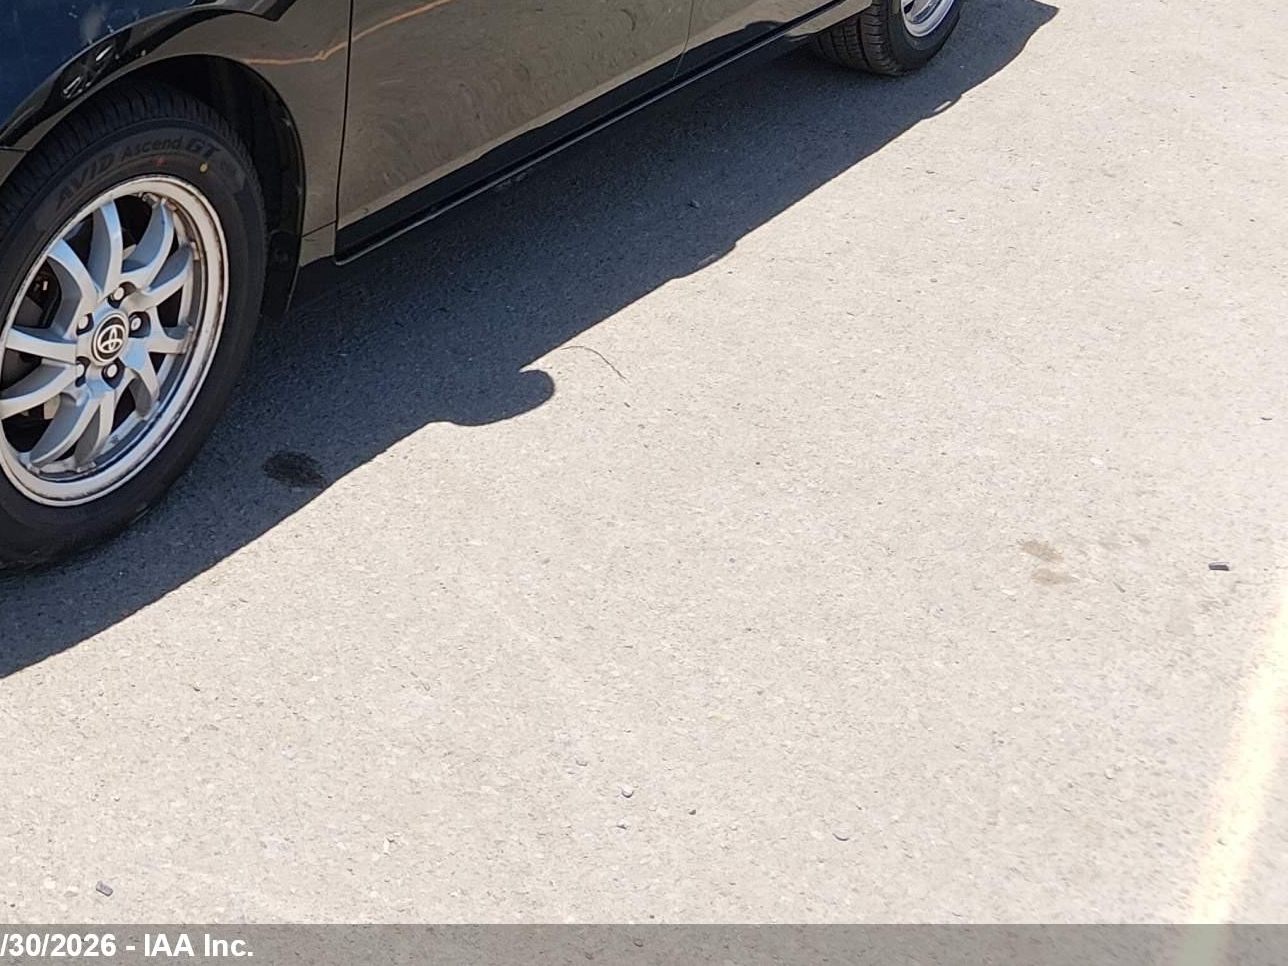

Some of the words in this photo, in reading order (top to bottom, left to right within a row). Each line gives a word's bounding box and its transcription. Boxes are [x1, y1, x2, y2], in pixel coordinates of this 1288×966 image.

[55, 153, 115, 212] AVID
[119, 136, 184, 161] Ascend
[185, 137, 221, 158] GT
